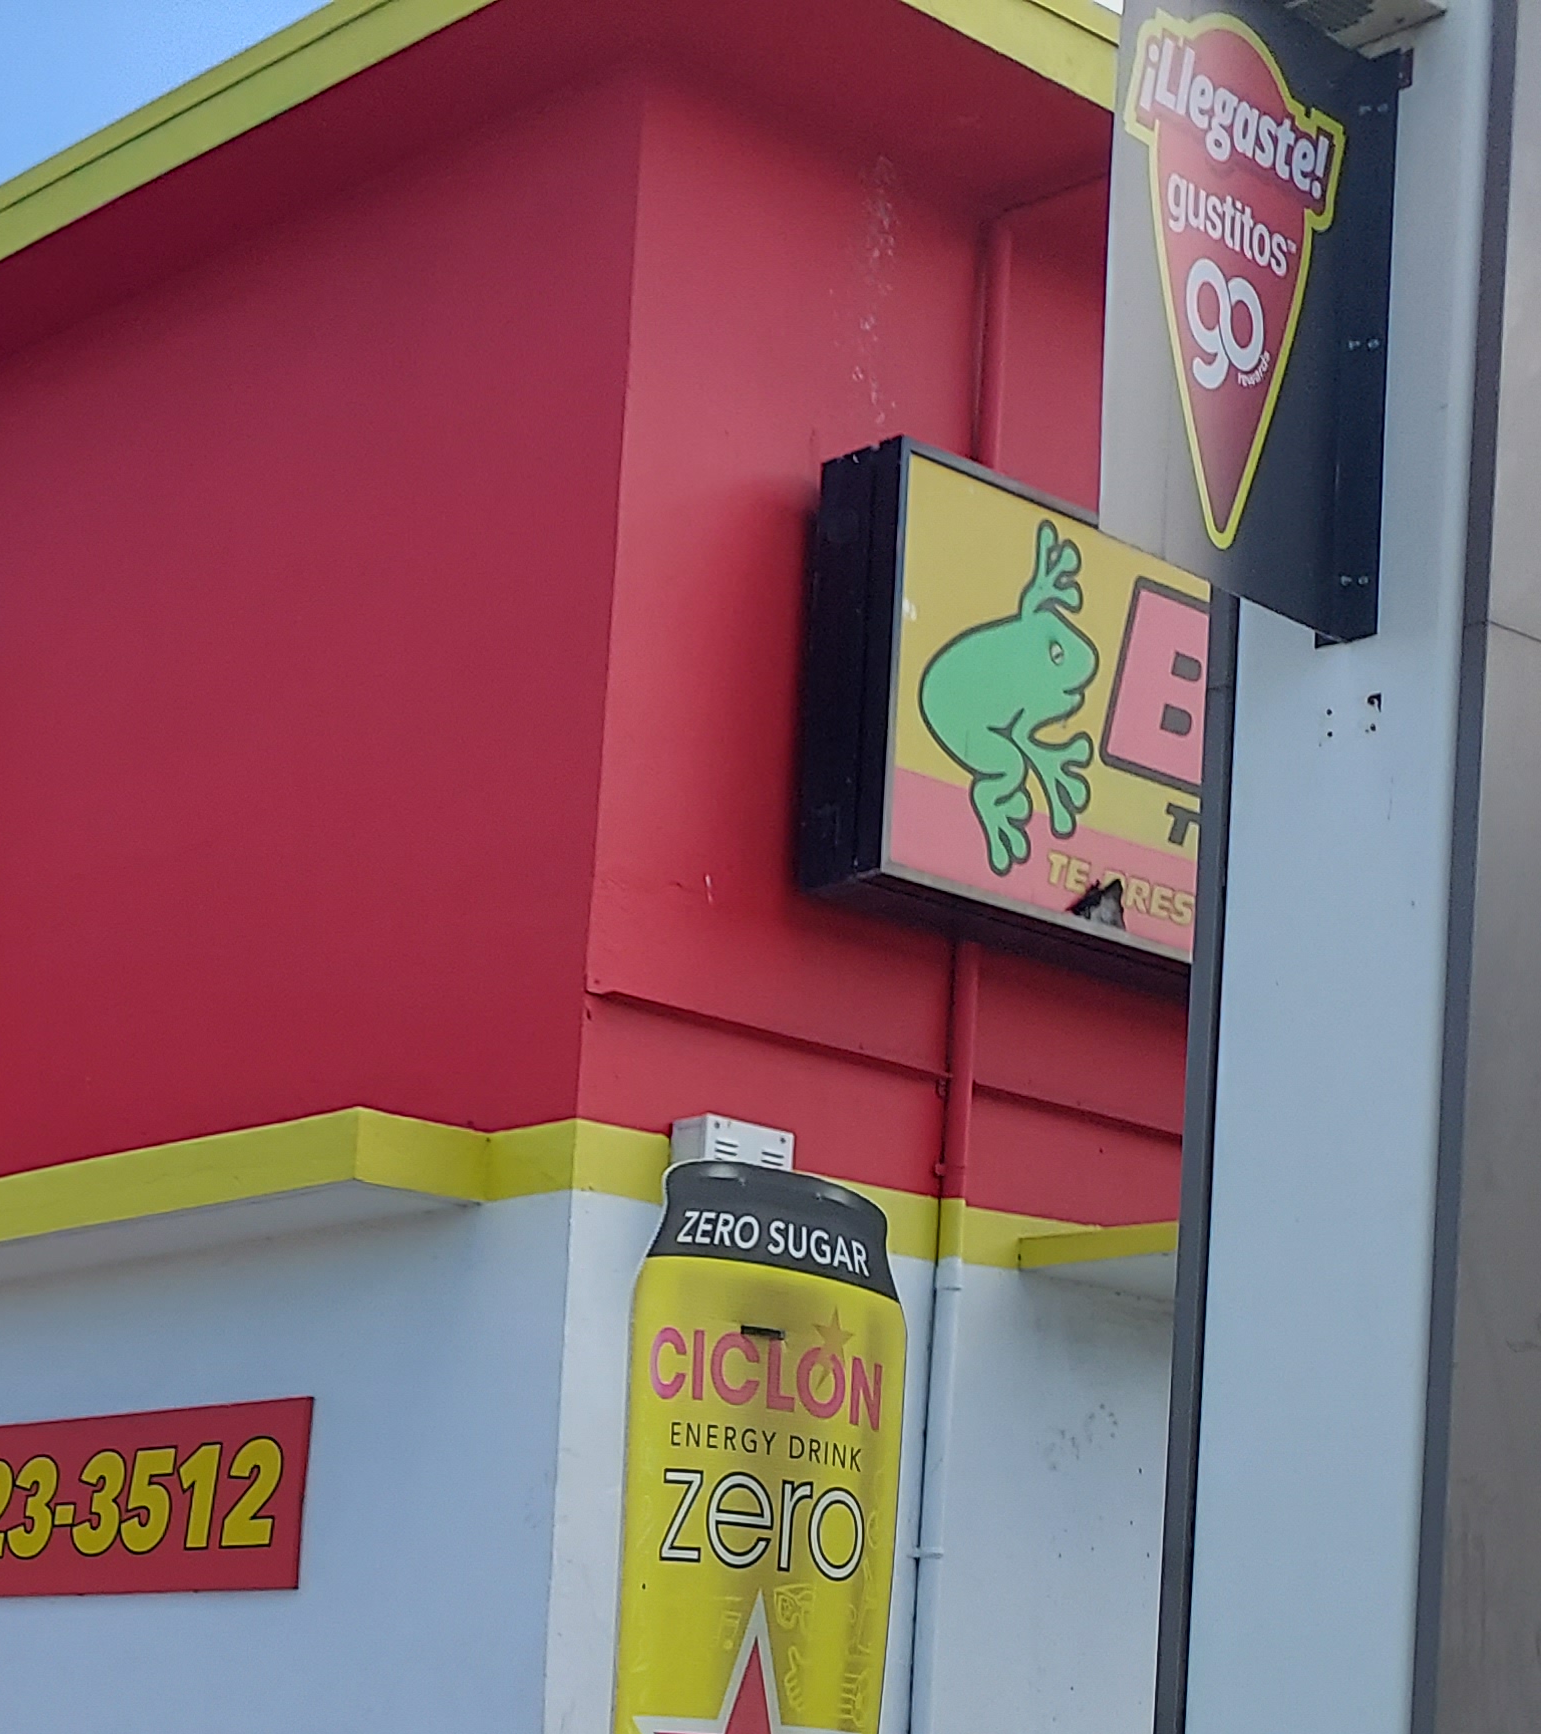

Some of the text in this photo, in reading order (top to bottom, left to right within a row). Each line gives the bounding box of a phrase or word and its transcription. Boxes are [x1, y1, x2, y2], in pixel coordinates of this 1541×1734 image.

[1139, 38, 1330, 200] ¡Llegaste!
[1185, 257, 1265, 390] go
[1047, 850, 1092, 895] TE
[676, 1209, 871, 1278] ZERO SUGAR
[670, 1421, 863, 1473] ENERGY DRINK
[659, 1467, 865, 1582] zero
